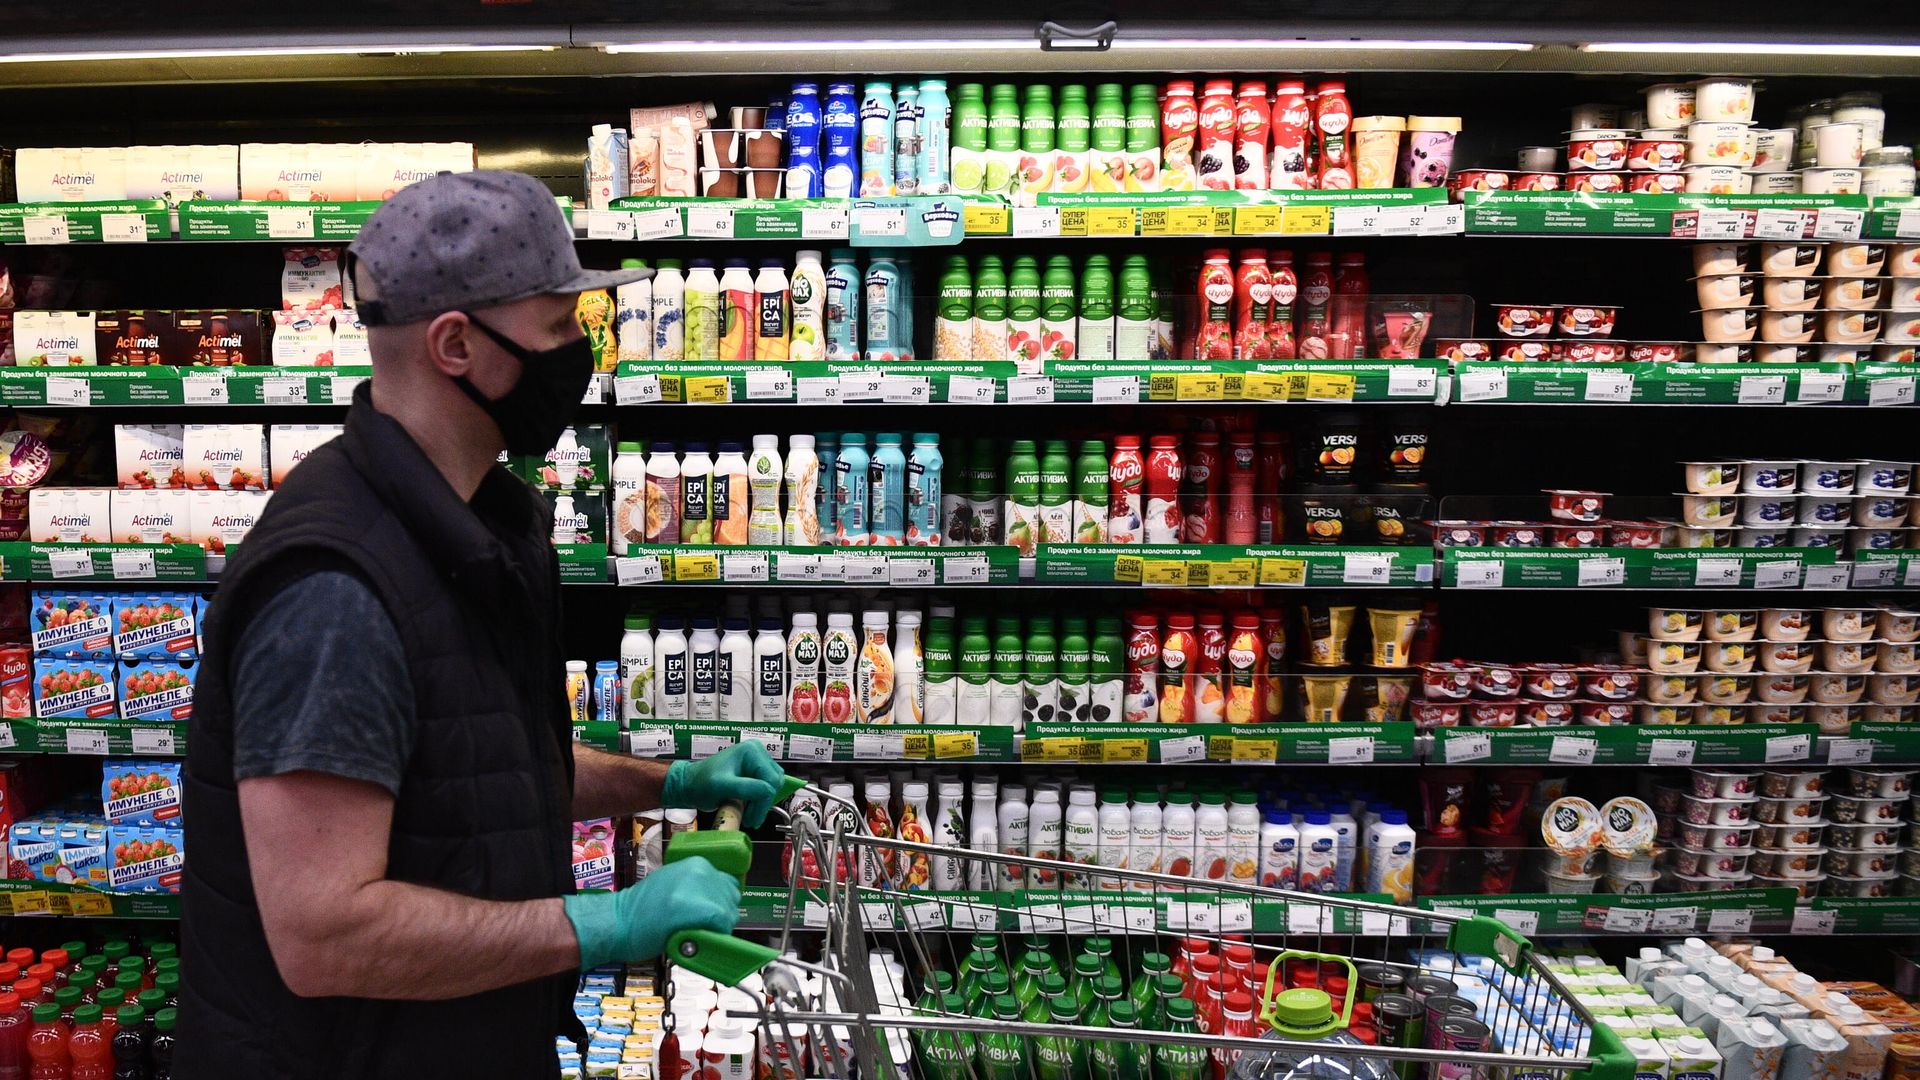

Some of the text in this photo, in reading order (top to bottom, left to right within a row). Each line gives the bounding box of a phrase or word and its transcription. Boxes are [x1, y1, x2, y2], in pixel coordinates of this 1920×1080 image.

[961, 119, 987, 128] АКТИВ
[52, 173, 95, 185] Actimel
[161, 172, 203, 183] Actimel
[278, 170, 322, 182] Actimel
[620, 201, 654, 209] Продукты
[924, 212, 959, 222] Верховье
[1063, 211, 1086, 219] СУПЕР
[1063, 218, 1085, 226] ЦЕНА
[977, 289, 1006, 298] АКТИВИ
[1042, 289, 1073, 298] АКТИВИА
[763, 311, 780, 321] CA
[36, 337, 78, 349] Actimel
[116, 336, 159, 348] Actimel
[199, 335, 242, 348] Actimel
[629, 364, 664, 373] Продукты
[724, 364, 762, 372] молочного
[1055, 364, 1090, 372] Продукты
[1092, 363, 1105, 371] без
[1152, 364, 1192, 372] молочного
[1194, 364, 1212, 372] жира
[1702, 366, 1715, 374] без
[1152, 383, 1174, 391] ЦЕНА
[203, 449, 242, 462] Actimel
[546, 448, 591, 461] Actimel
[1014, 475, 1039, 484] АКТИВ
[1084, 475, 1108, 484] АКТИВ
[687, 494, 704, 504] CA
[1305, 508, 1342, 518] VERSA
[50, 514, 91, 527] Actimel
[132, 513, 173, 526] Actimel
[212, 515, 254, 527] Actimel
[1047, 547, 1081, 556] Продукты
[1455, 550, 1490, 558] Продукты
[1118, 565, 1140, 573] ЦЕНА
[37, 621, 94, 642] ИМУНЕЛЕ
[119, 621, 176, 644] ИМУНЕЛЕ
[800, 641, 815, 650] BIO
[830, 641, 844, 650] BIO
[798, 650, 816, 659] MAX
[829, 650, 846, 659] MAX
[622, 657, 648, 666] SIMPLE
[668, 672, 683, 680] CA
[39, 688, 96, 709] ИМУНЕЛЕ
[124, 691, 181, 711] ИМУНЕЛЕ
[108, 791, 162, 811] ИМУНЕЛЕ
[1556, 809, 1571, 821] BIO
[1611, 810, 1625, 820] BIO
[1558, 817, 1578, 829] MAX
[1614, 816, 1633, 829] MAX
[18, 842, 55, 857] IMMUNO
[64, 846, 99, 861] IMMUNO
[28, 851, 54, 866] Lakto
[74, 855, 100, 870] Lakto
[113, 858, 168, 878] ИМУНЕЛЕ
